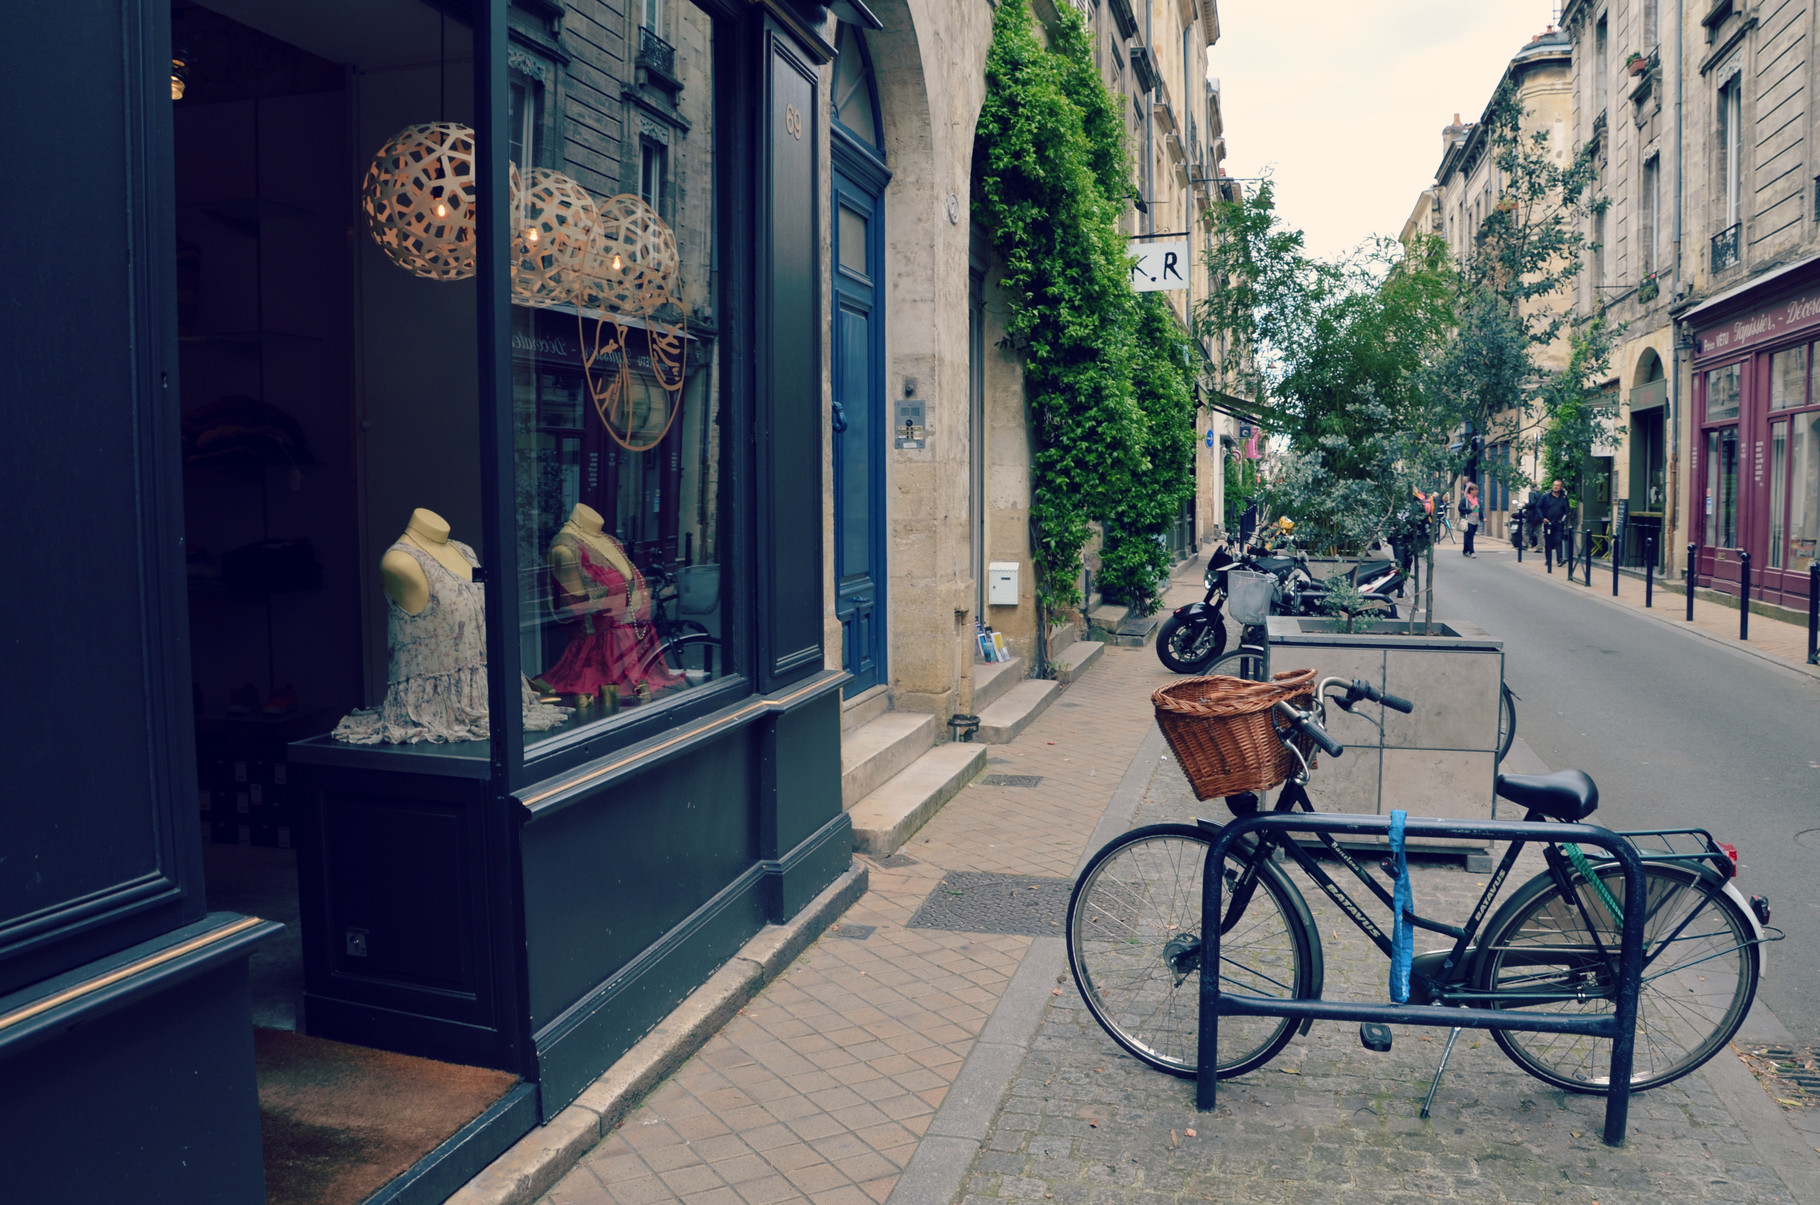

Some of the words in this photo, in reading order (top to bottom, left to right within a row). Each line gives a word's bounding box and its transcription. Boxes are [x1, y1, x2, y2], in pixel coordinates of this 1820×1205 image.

[785, 103, 802, 140] 69
[1326, 884, 1381, 938] BATAVUS
[1475, 869, 1506, 922] BATAVUS
